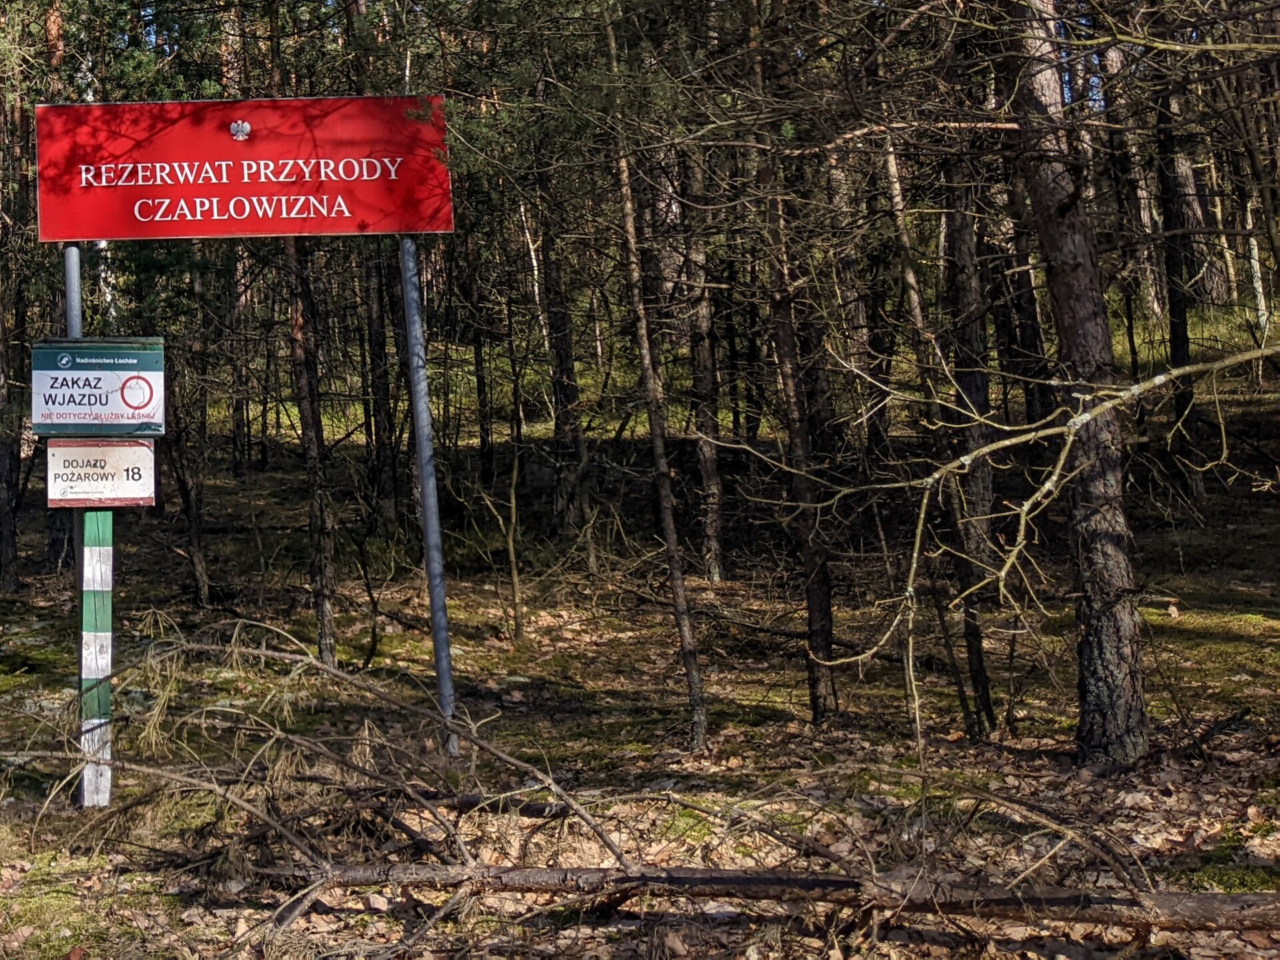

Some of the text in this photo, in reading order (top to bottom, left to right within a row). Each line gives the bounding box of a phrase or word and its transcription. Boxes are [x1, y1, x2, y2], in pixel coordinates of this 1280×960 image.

[79, 157, 403, 187] REZERWAT PRZYRODY
[133, 195, 352, 222] CZAPLOWIZNA
[49, 377, 102, 389] ZAKAZ
[43, 393, 109, 406] WJAZDU
[41, 412, 53, 420] NIE
[56, 412, 92, 420] DOTYCZY
[94, 411, 124, 420] SŁUŻBY
[63, 459, 107, 469] DOJAZD
[54, 467, 142, 483] POŻAROWY 18
